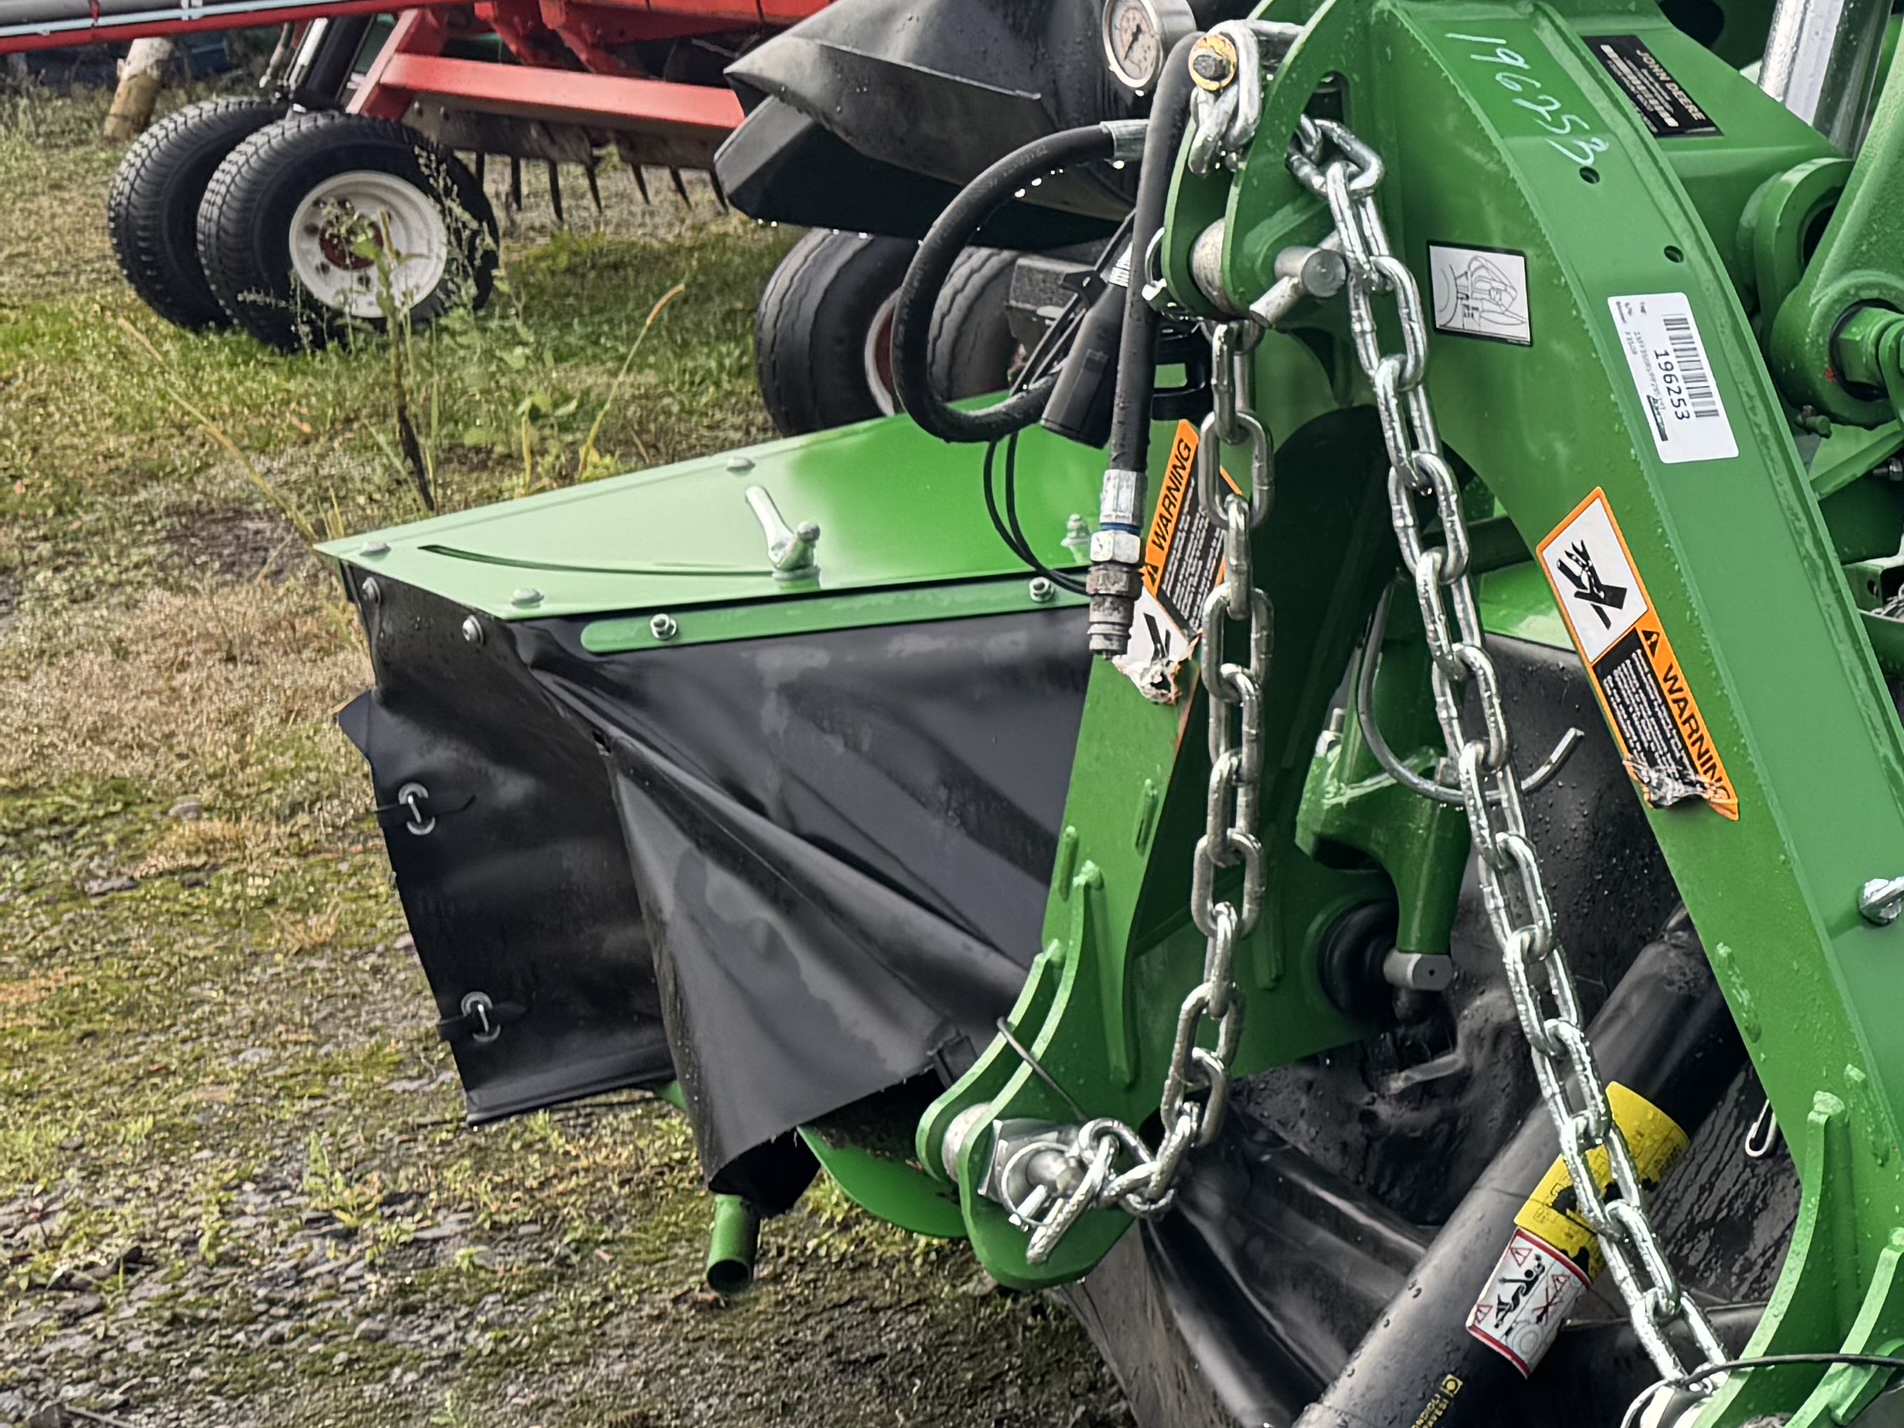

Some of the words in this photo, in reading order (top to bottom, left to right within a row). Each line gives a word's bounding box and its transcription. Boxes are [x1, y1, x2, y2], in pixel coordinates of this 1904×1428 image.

[1445, 33, 1610, 166] 196253
[1636, 49, 1672, 83] JOHN
[1667, 81, 1706, 122] DEERE
[1654, 348, 1691, 421] 196253
[1151, 438, 1193, 552] WARNING
